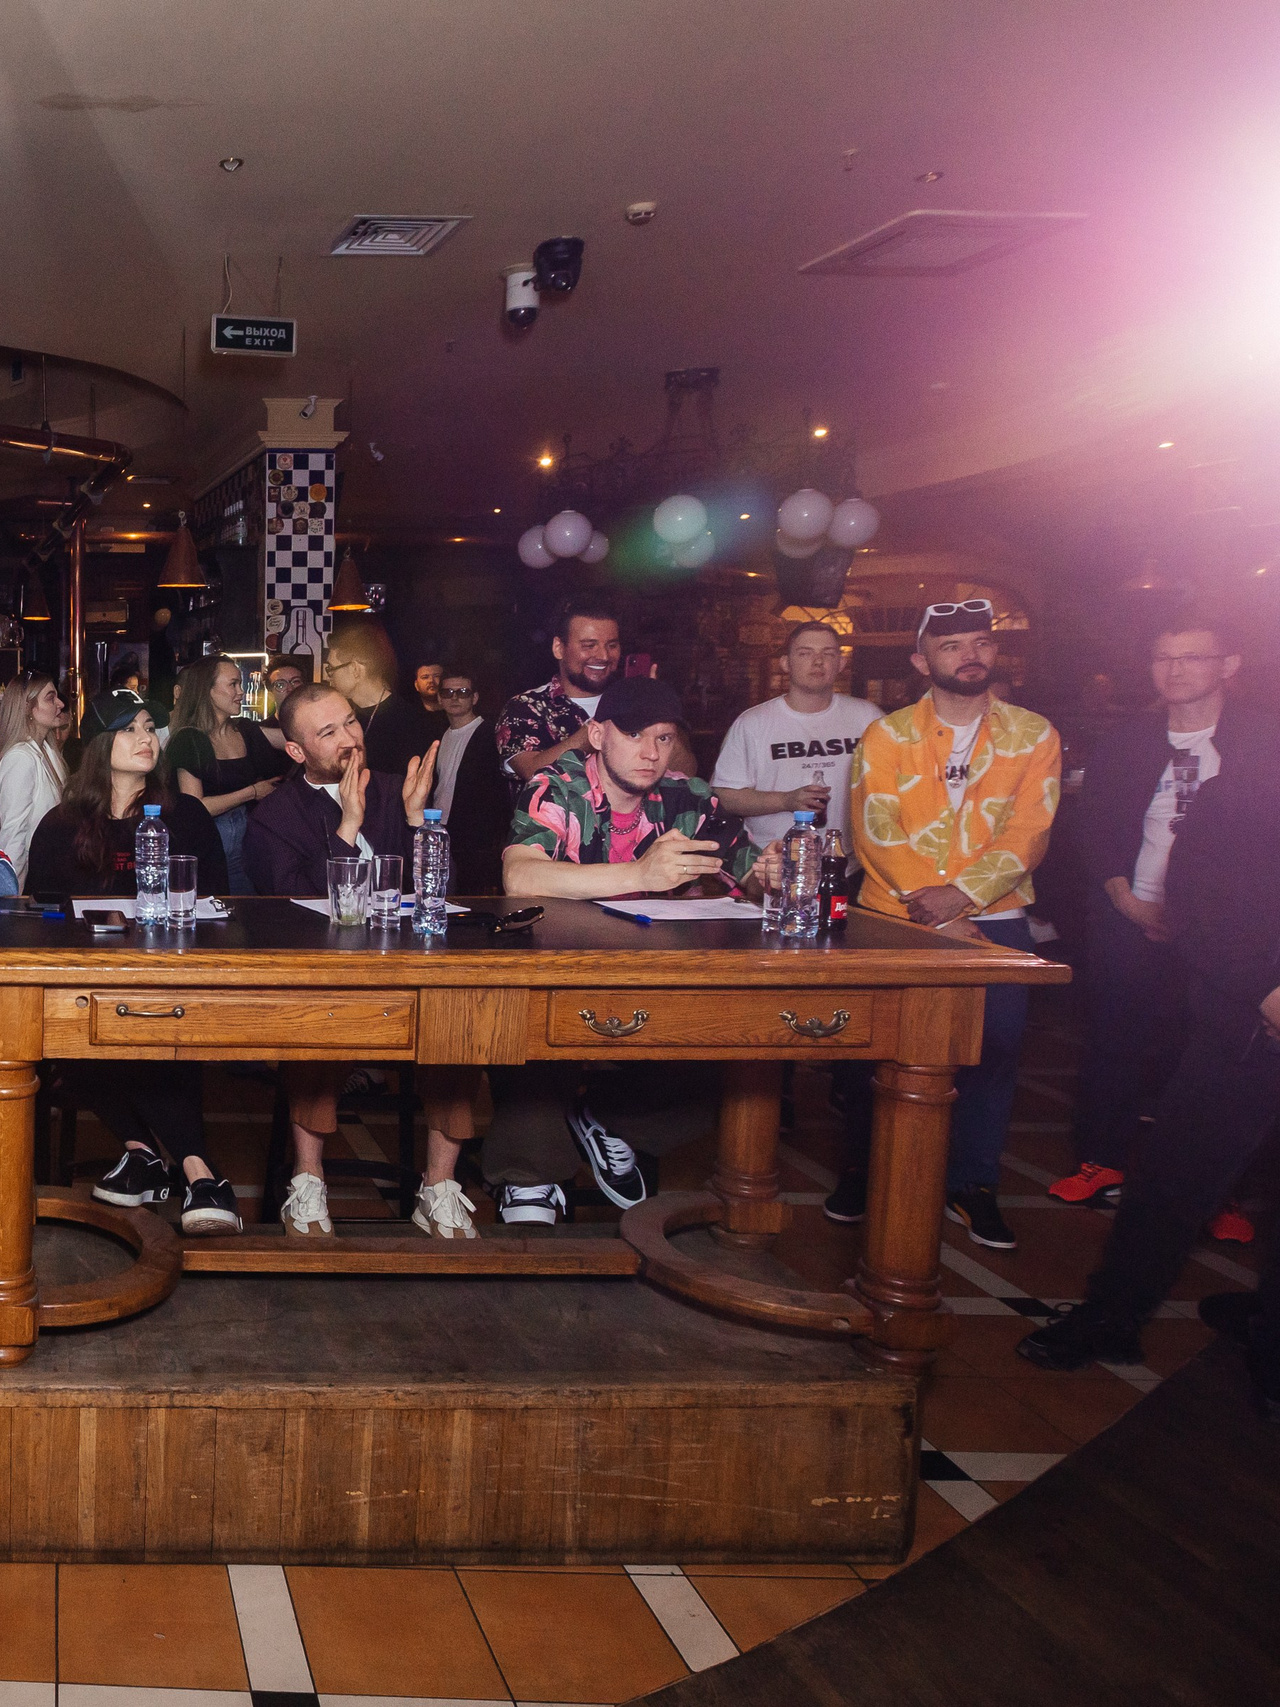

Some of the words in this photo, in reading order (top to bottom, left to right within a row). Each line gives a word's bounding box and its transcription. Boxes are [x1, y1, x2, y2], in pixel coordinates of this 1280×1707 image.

[245, 326, 286, 339] ВЫХОД
[245, 337, 275, 347] EXIT
[801, 761, 836, 770] 24/7/365
